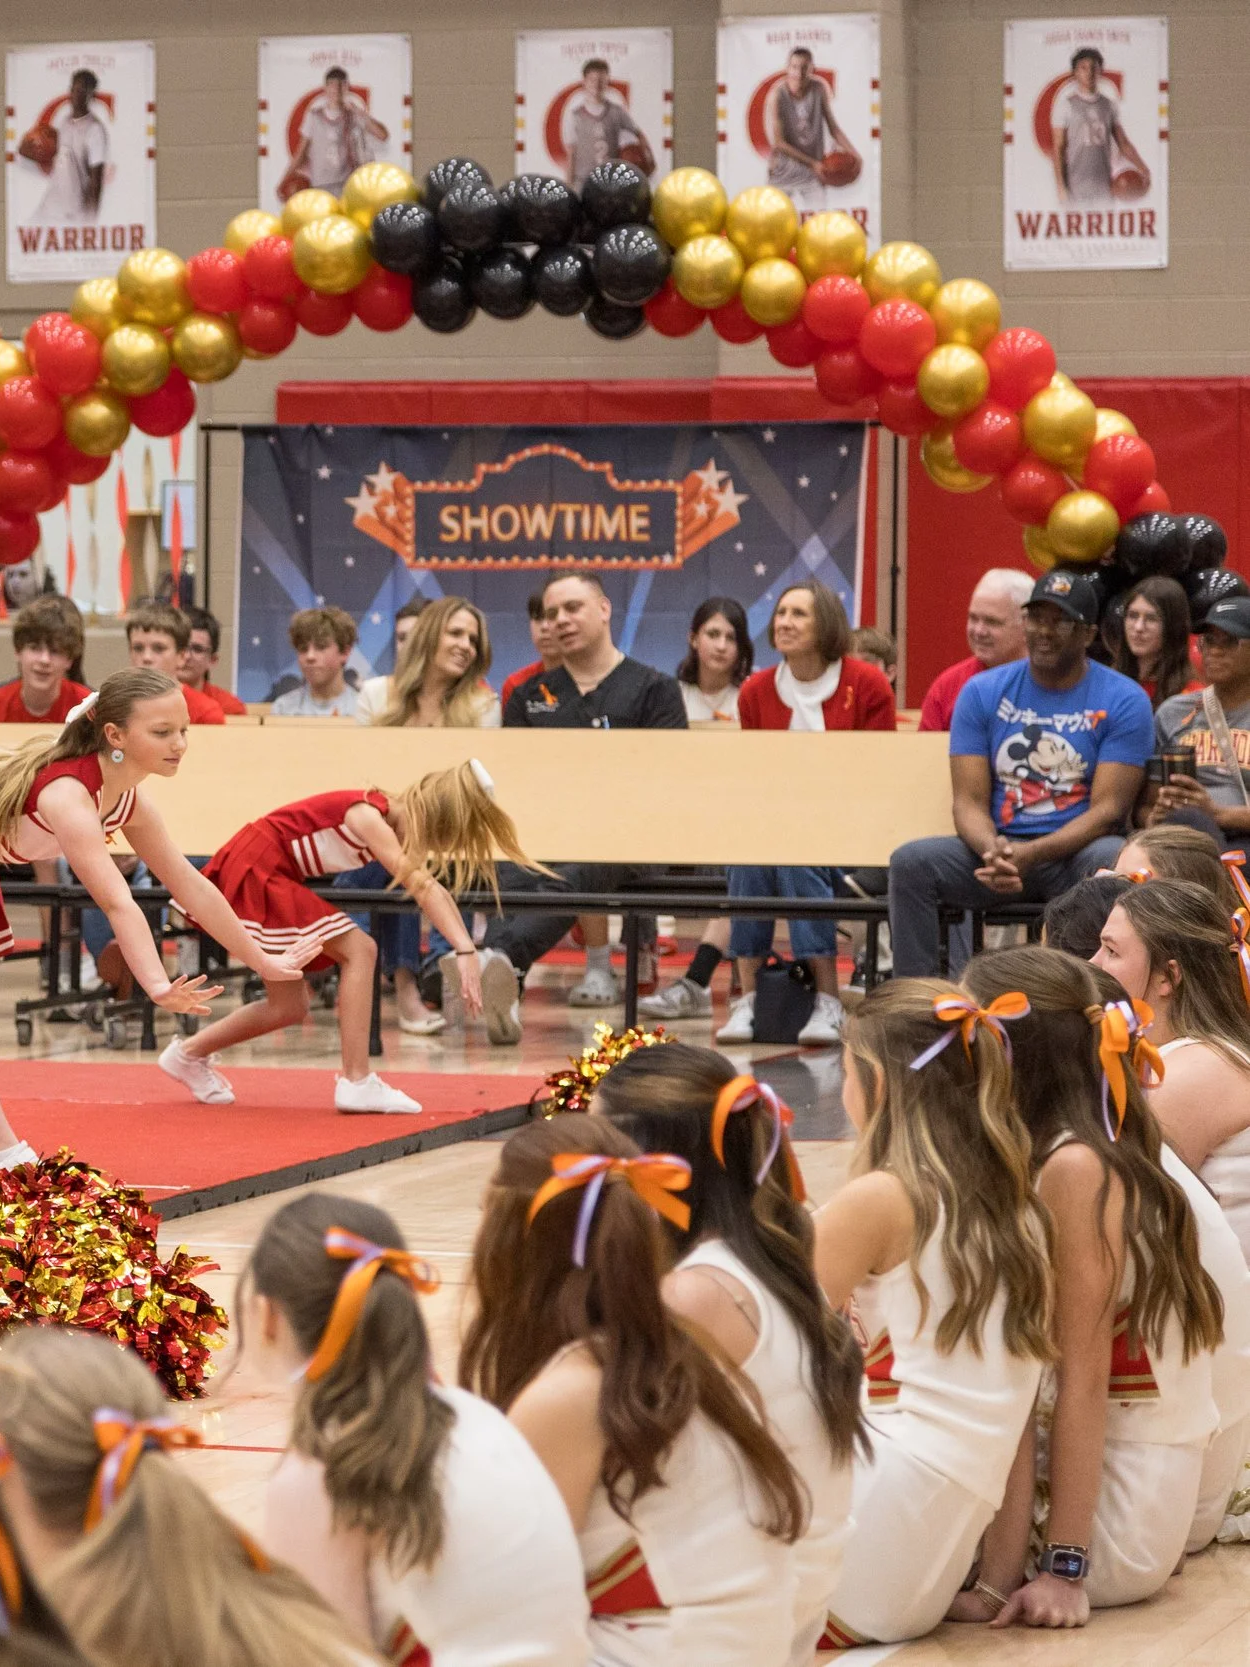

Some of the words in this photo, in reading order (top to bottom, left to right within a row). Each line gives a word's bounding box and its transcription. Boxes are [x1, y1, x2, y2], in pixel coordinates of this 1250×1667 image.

[17, 223, 146, 254] WARRIOR
[1015, 208, 1157, 240] WARRIOR
[438, 502, 650, 543] SHOWTIME
